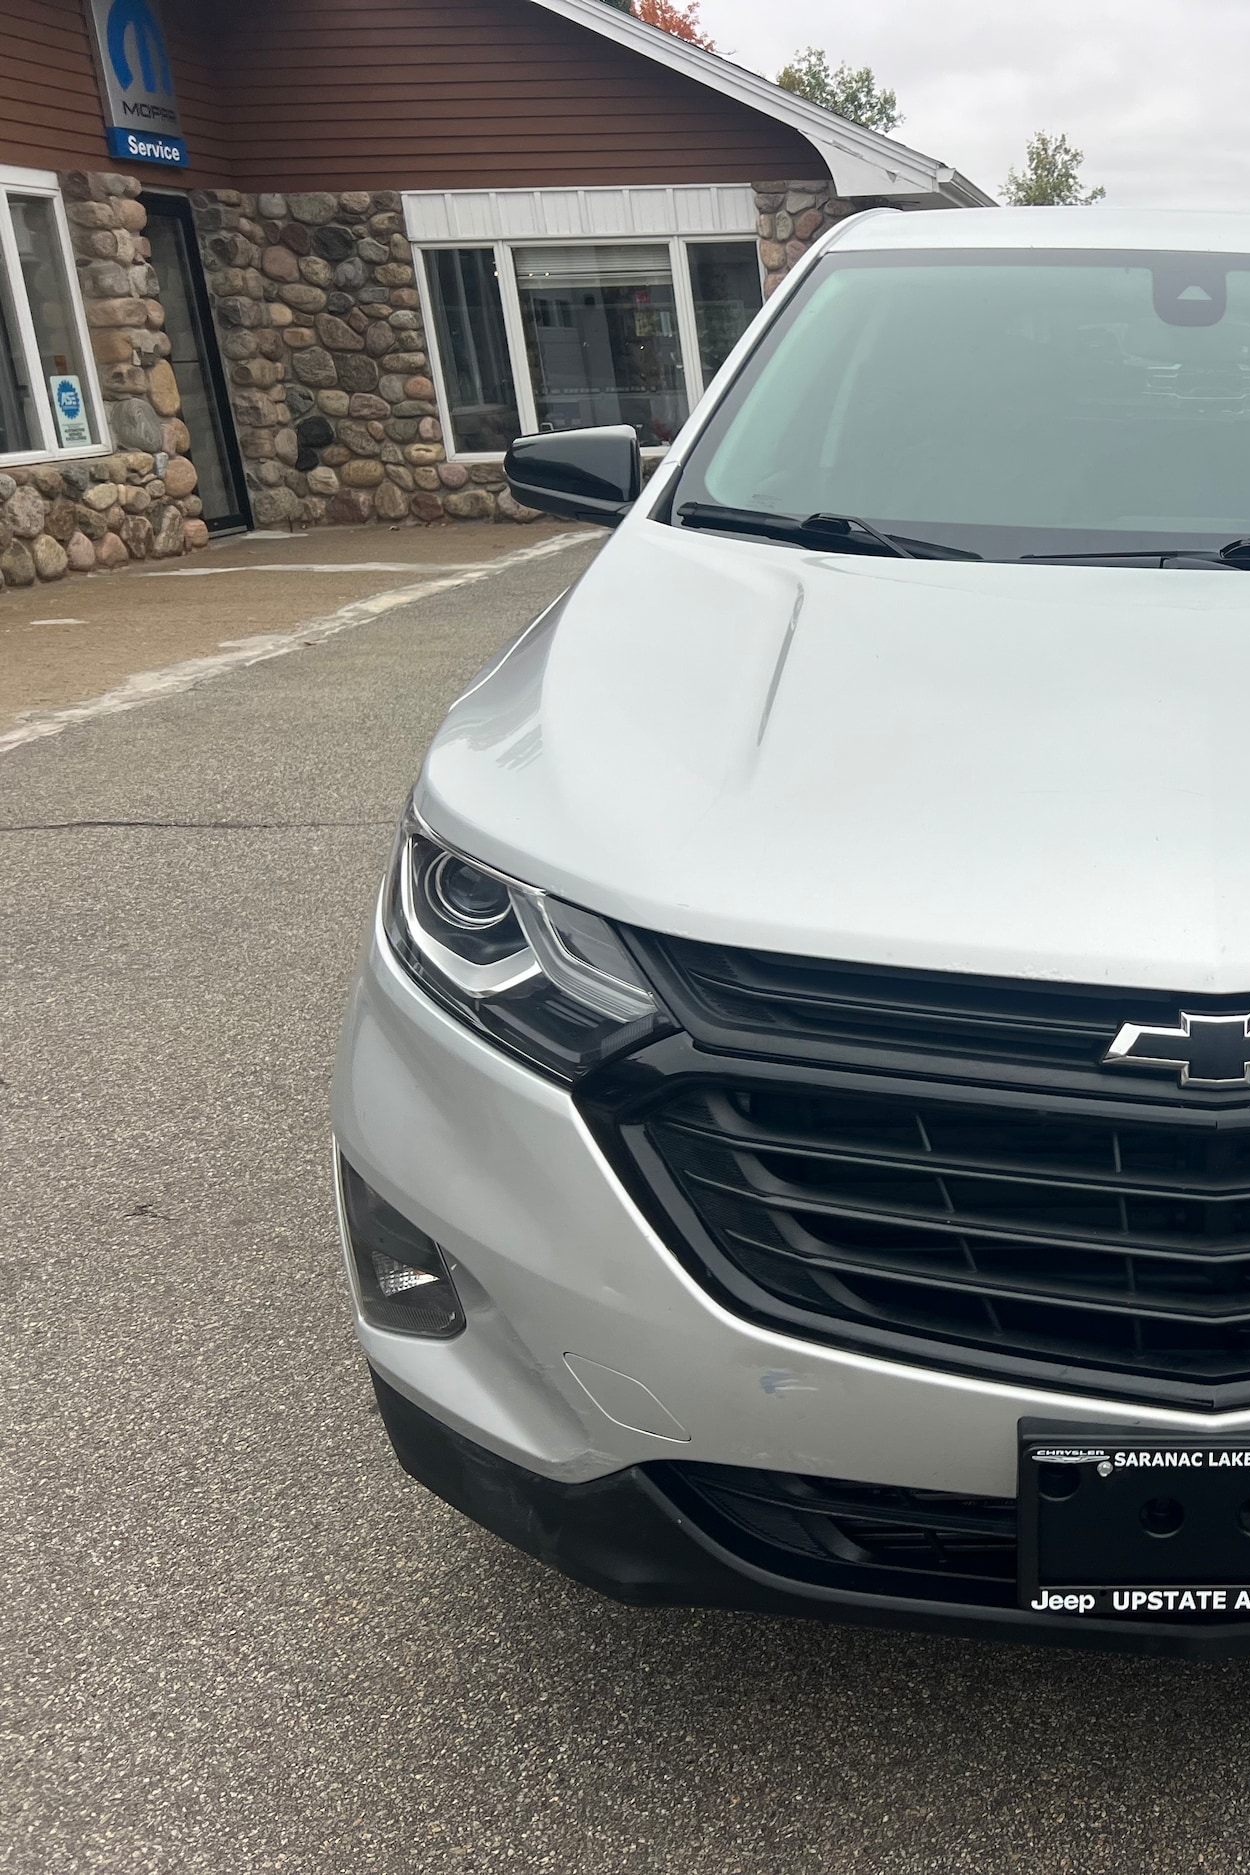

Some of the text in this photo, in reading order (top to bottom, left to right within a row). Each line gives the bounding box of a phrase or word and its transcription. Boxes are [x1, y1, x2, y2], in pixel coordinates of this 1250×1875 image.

[127, 135, 180, 161] Service
[1114, 1452, 1203, 1467] SARANAC
[1031, 1590, 1095, 1613] Jeep
[1113, 1590, 1227, 1610] UPSTATE
